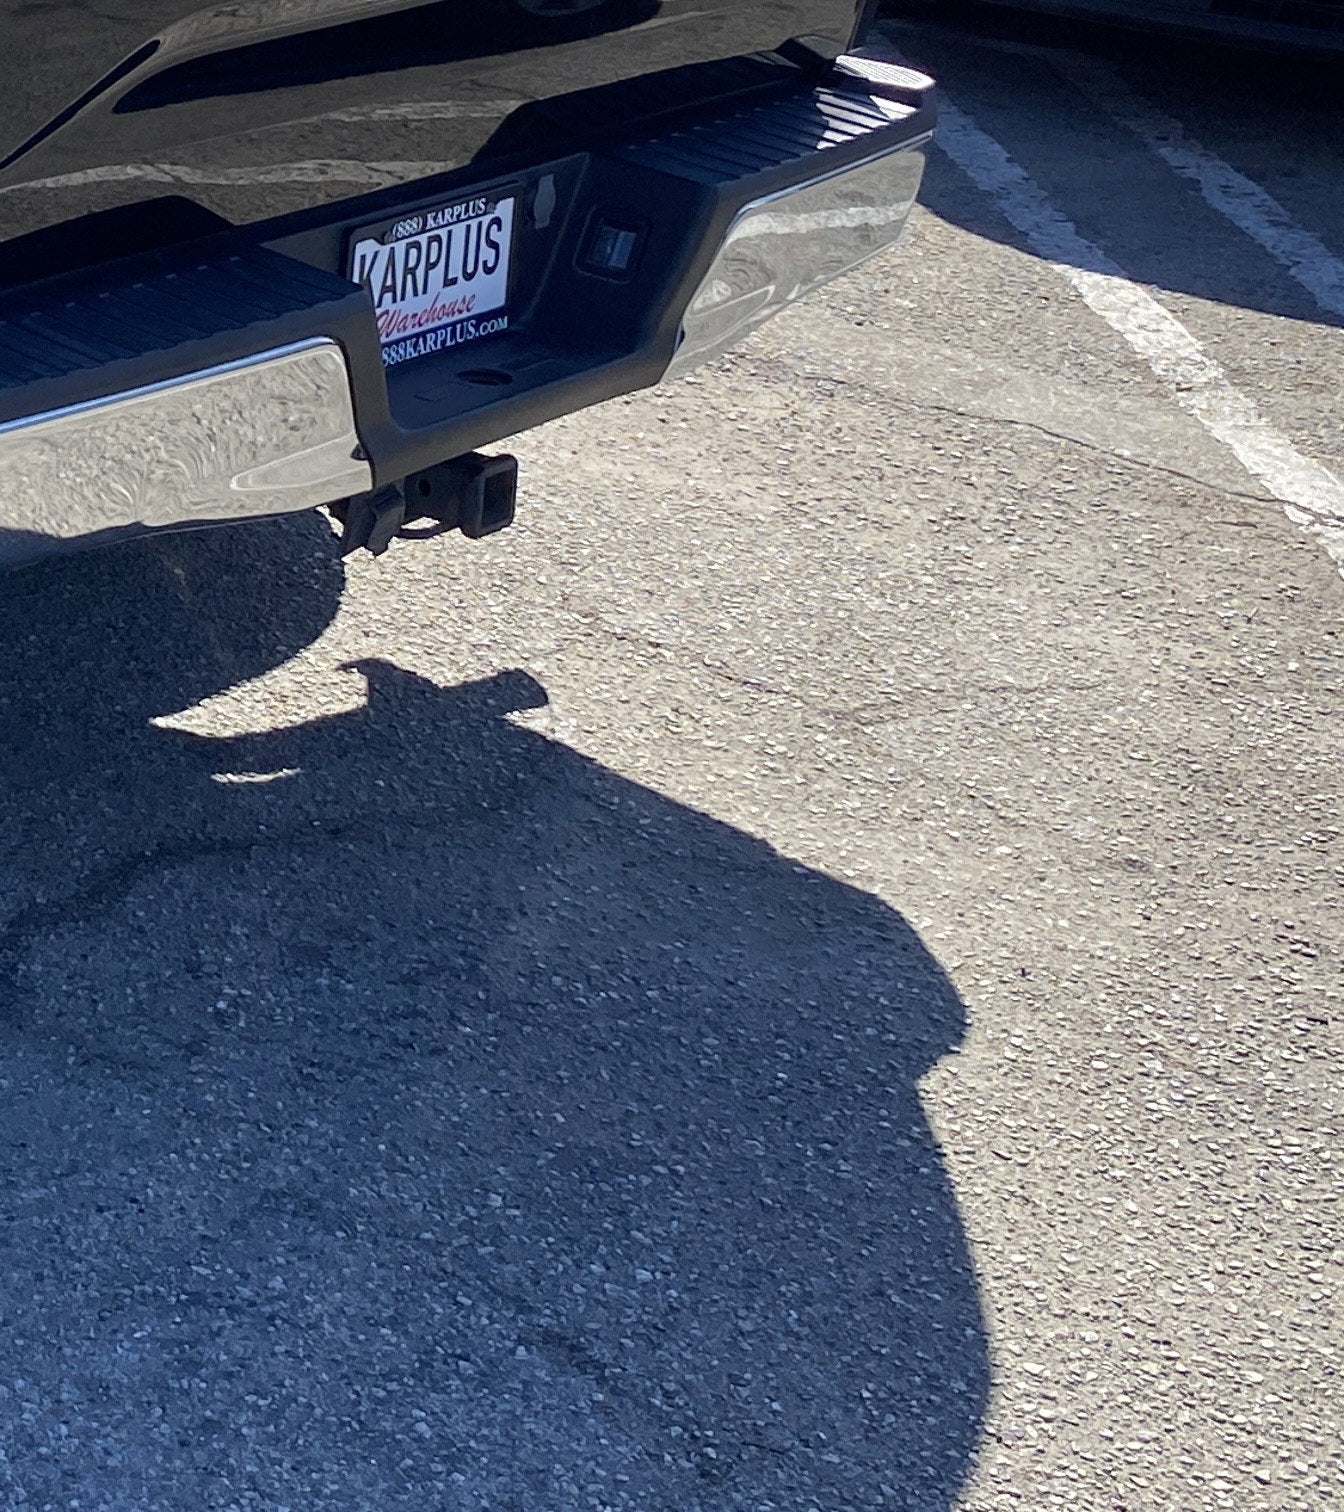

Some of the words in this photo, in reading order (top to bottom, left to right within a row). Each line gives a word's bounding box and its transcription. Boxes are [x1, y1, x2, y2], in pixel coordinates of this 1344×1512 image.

[391, 215, 424, 239] (888)
[425, 197, 487, 230] KARPLUS
[358, 215, 503, 309] KARPLUS
[376, 291, 477, 339] Warehouse
